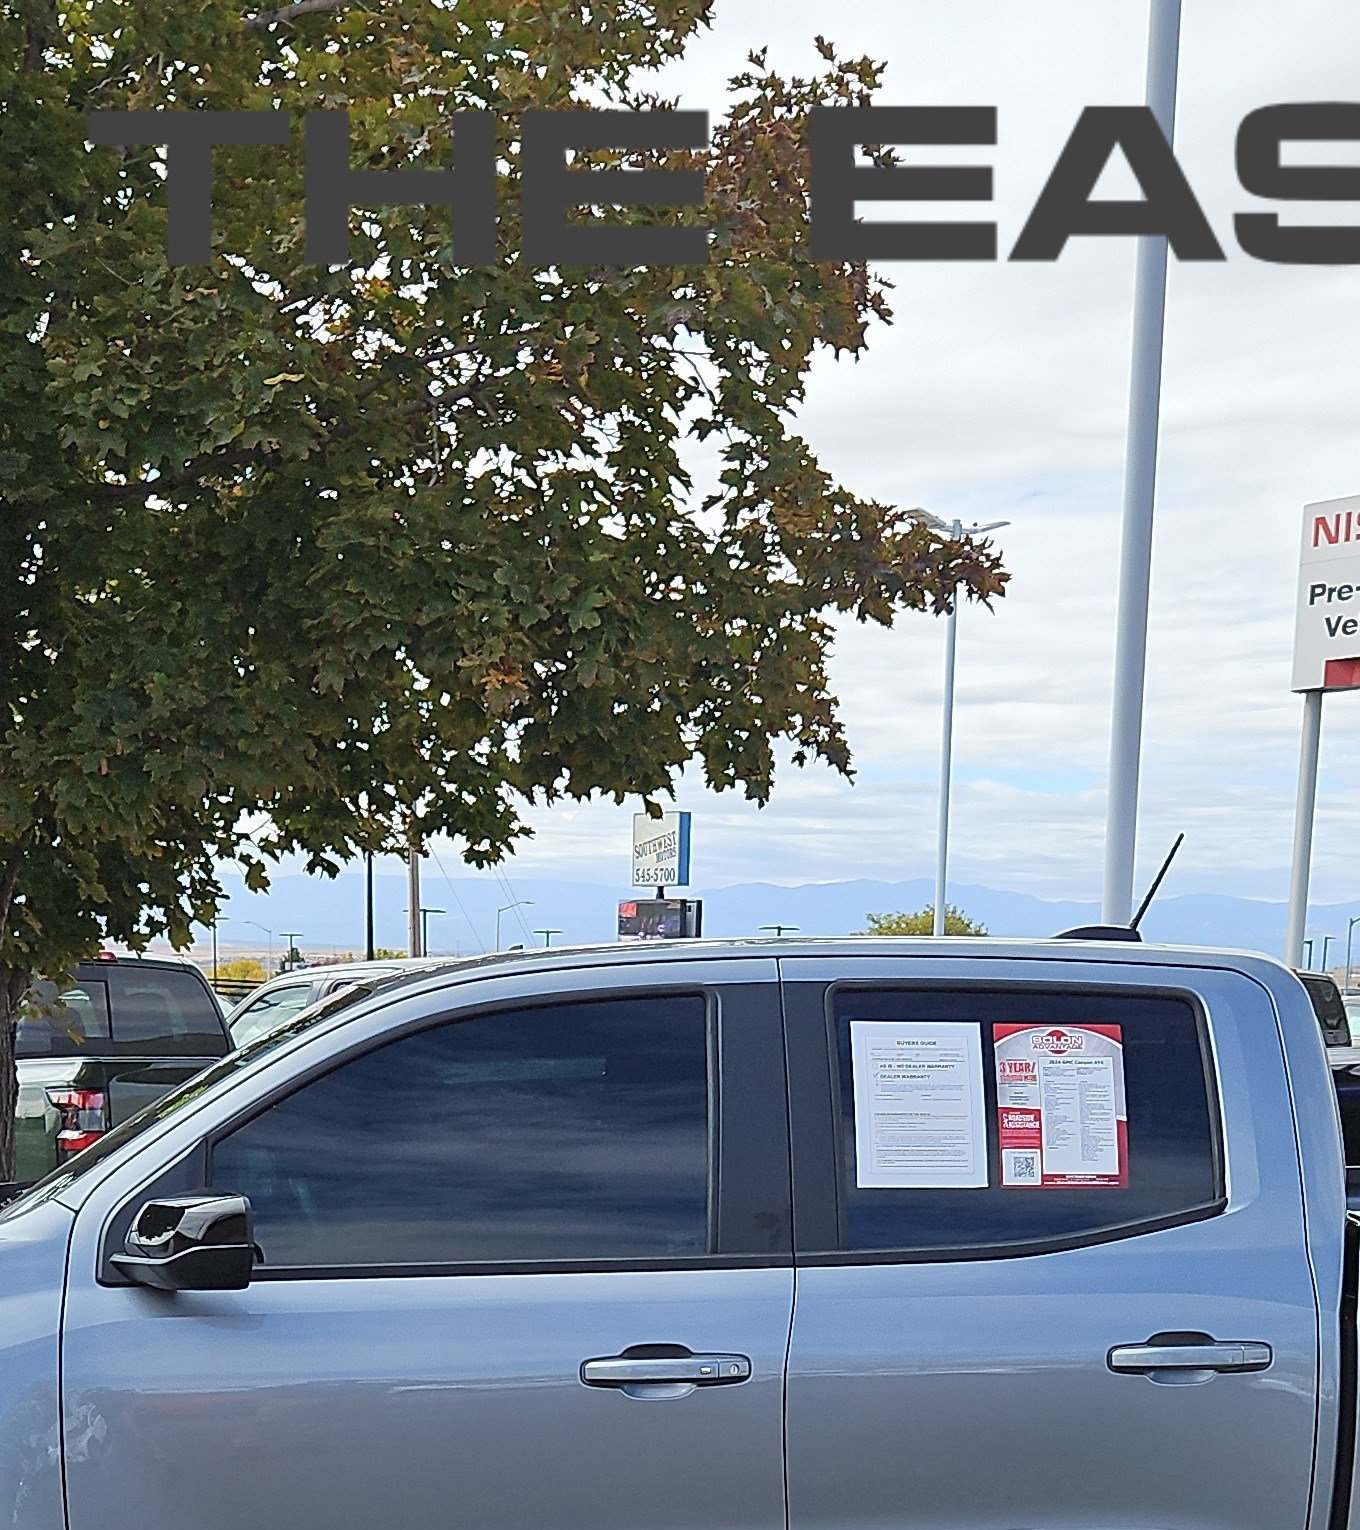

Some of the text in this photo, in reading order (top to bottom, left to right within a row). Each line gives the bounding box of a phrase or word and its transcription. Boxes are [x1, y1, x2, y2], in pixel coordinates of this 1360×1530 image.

[634, 830, 677, 860] SOUTHWEST
[634, 867, 676, 883] 545-5700
[1032, 1035, 1083, 1045] SOLON
[1007, 1062, 1036, 1073] YEAR/
